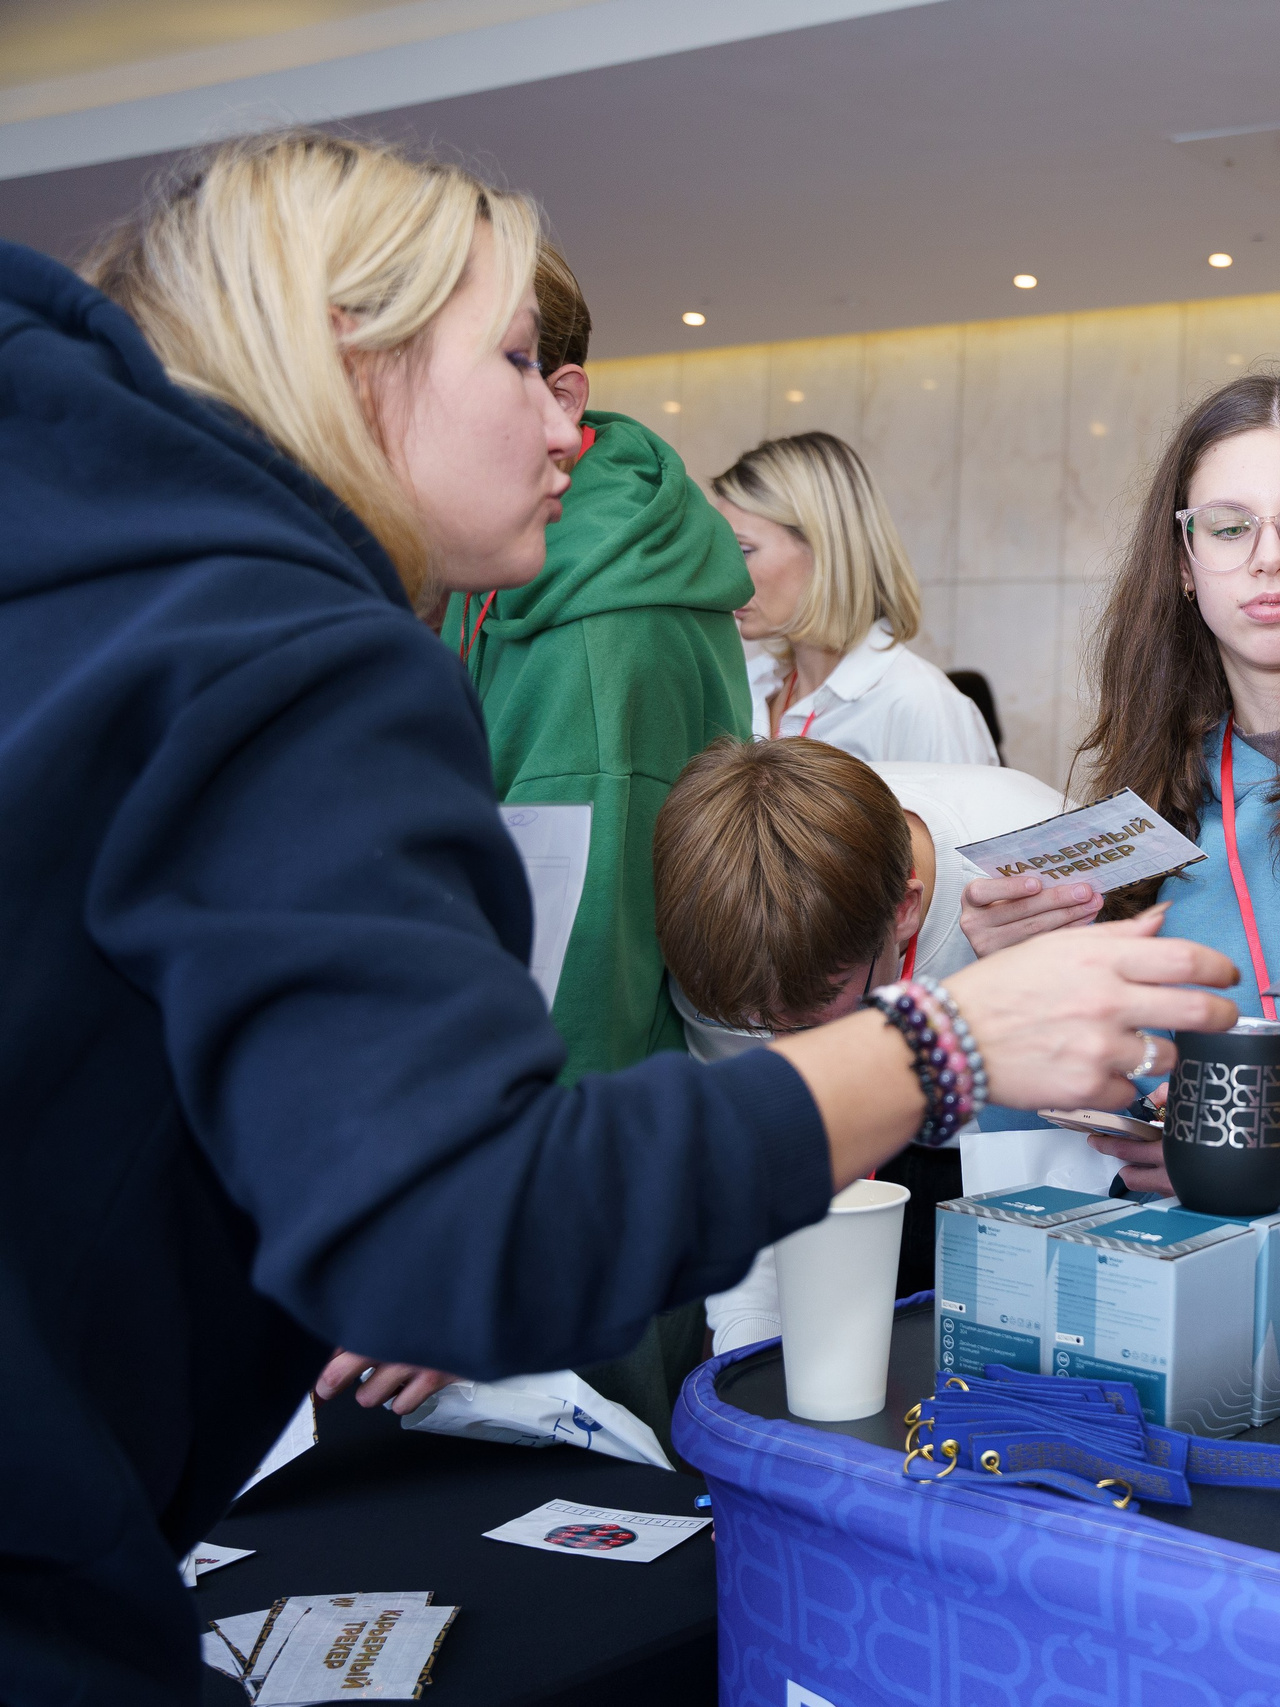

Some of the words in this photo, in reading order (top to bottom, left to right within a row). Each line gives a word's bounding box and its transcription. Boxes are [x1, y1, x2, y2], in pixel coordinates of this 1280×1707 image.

[996, 817, 1156, 877] КАРЬЕРНЫЙ
[1040, 844, 1136, 880] ТРЕКЕР
[323, 1620, 368, 1669] ТРЕКЕР
[341, 1609, 404, 1689] КАРЬЕРНЫЙ
